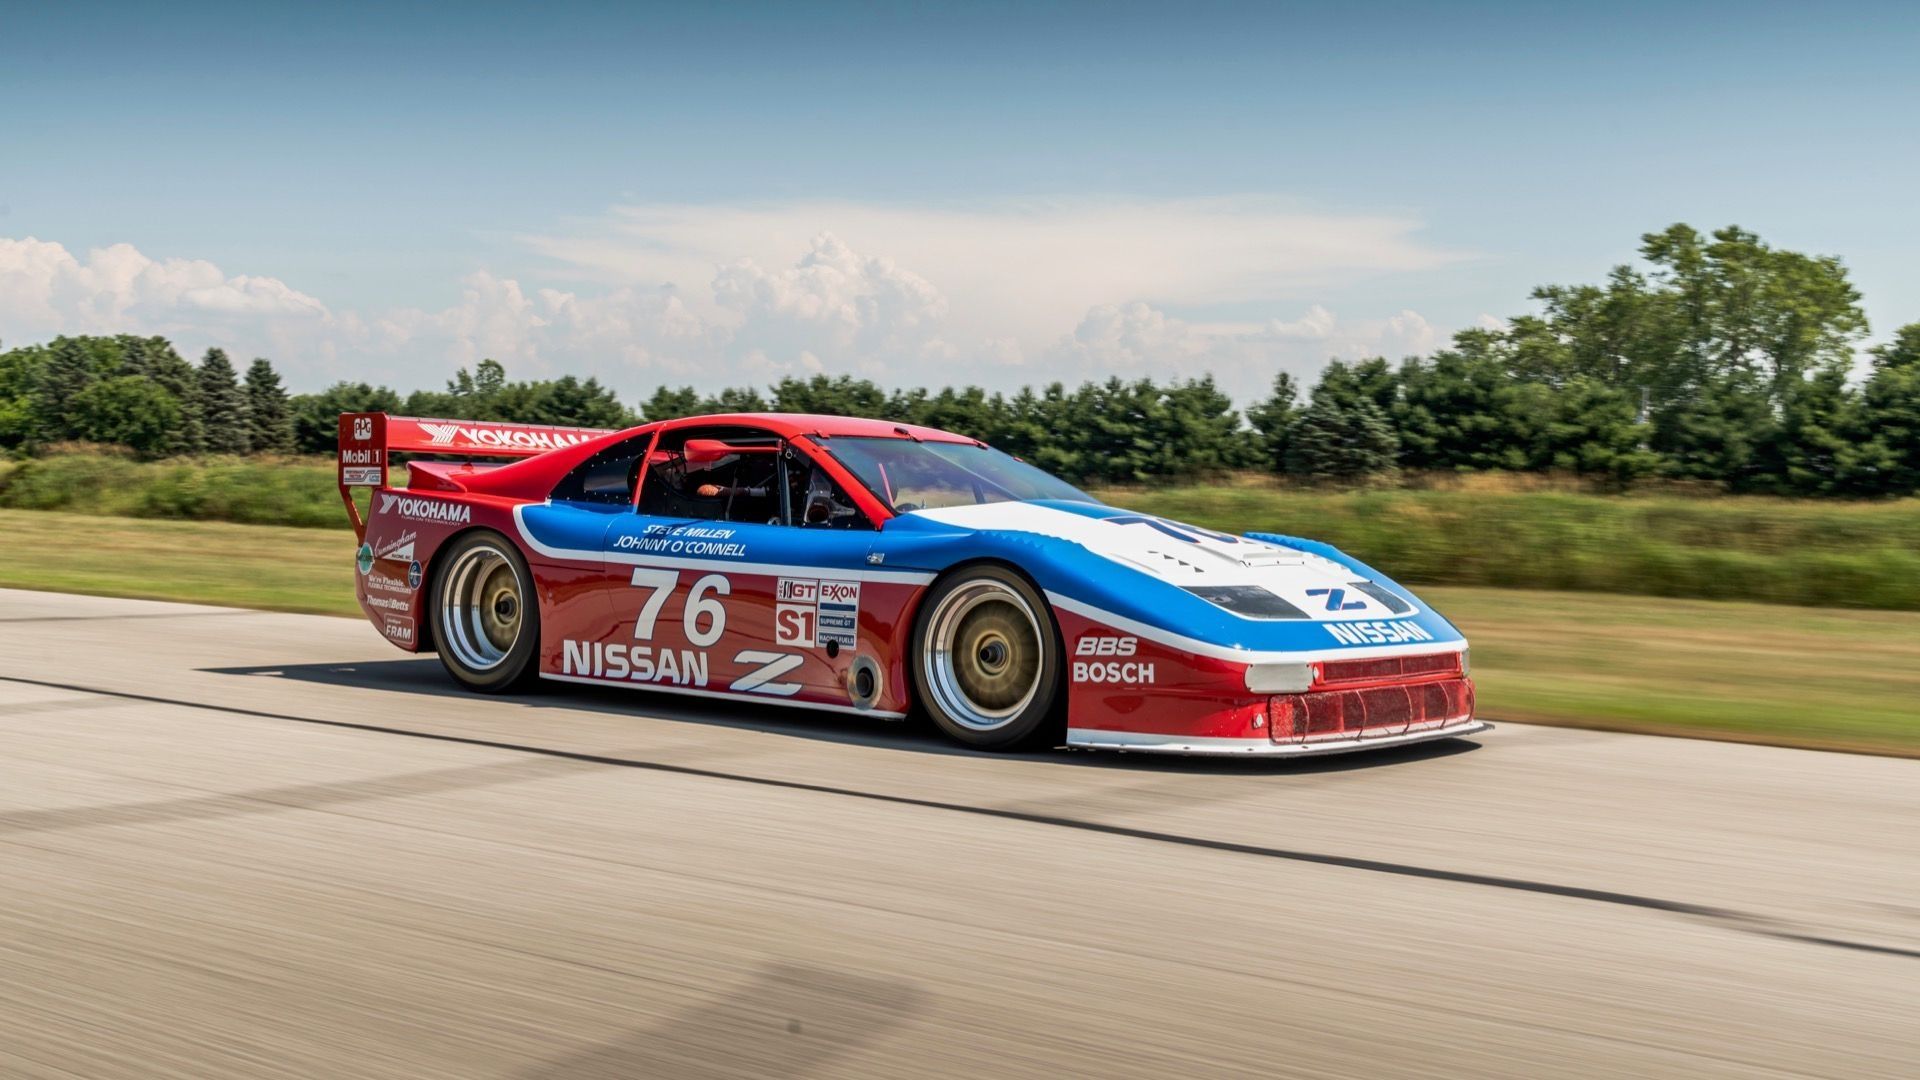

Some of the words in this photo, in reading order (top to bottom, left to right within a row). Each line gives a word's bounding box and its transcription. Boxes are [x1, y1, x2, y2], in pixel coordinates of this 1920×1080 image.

[355, 418, 371, 436] PPG
[342, 449, 370, 464] Mobil
[397, 497, 471, 523] YOKOHAMA
[374, 529, 417, 557] Cunningham
[643, 524, 683, 536] STEVE
[683, 526, 736, 540] MILLEN
[613, 535, 671, 552] JOHNNY
[671, 540, 746, 557] O'CONNELL
[792, 583, 816, 598] GT
[821, 583, 858, 602] EXXON
[1306, 587, 1368, 611] Z
[630, 567, 731, 647] 76
[385, 624, 412, 640] FRAM
[777, 608, 814, 642] S1
[1322, 620, 1435, 646] NISSAN
[1075, 636, 1138, 657] BBS
[562, 639, 709, 688] NISSAN
[729, 650, 804, 696] Z
[1072, 661, 1155, 684] BOSCH
